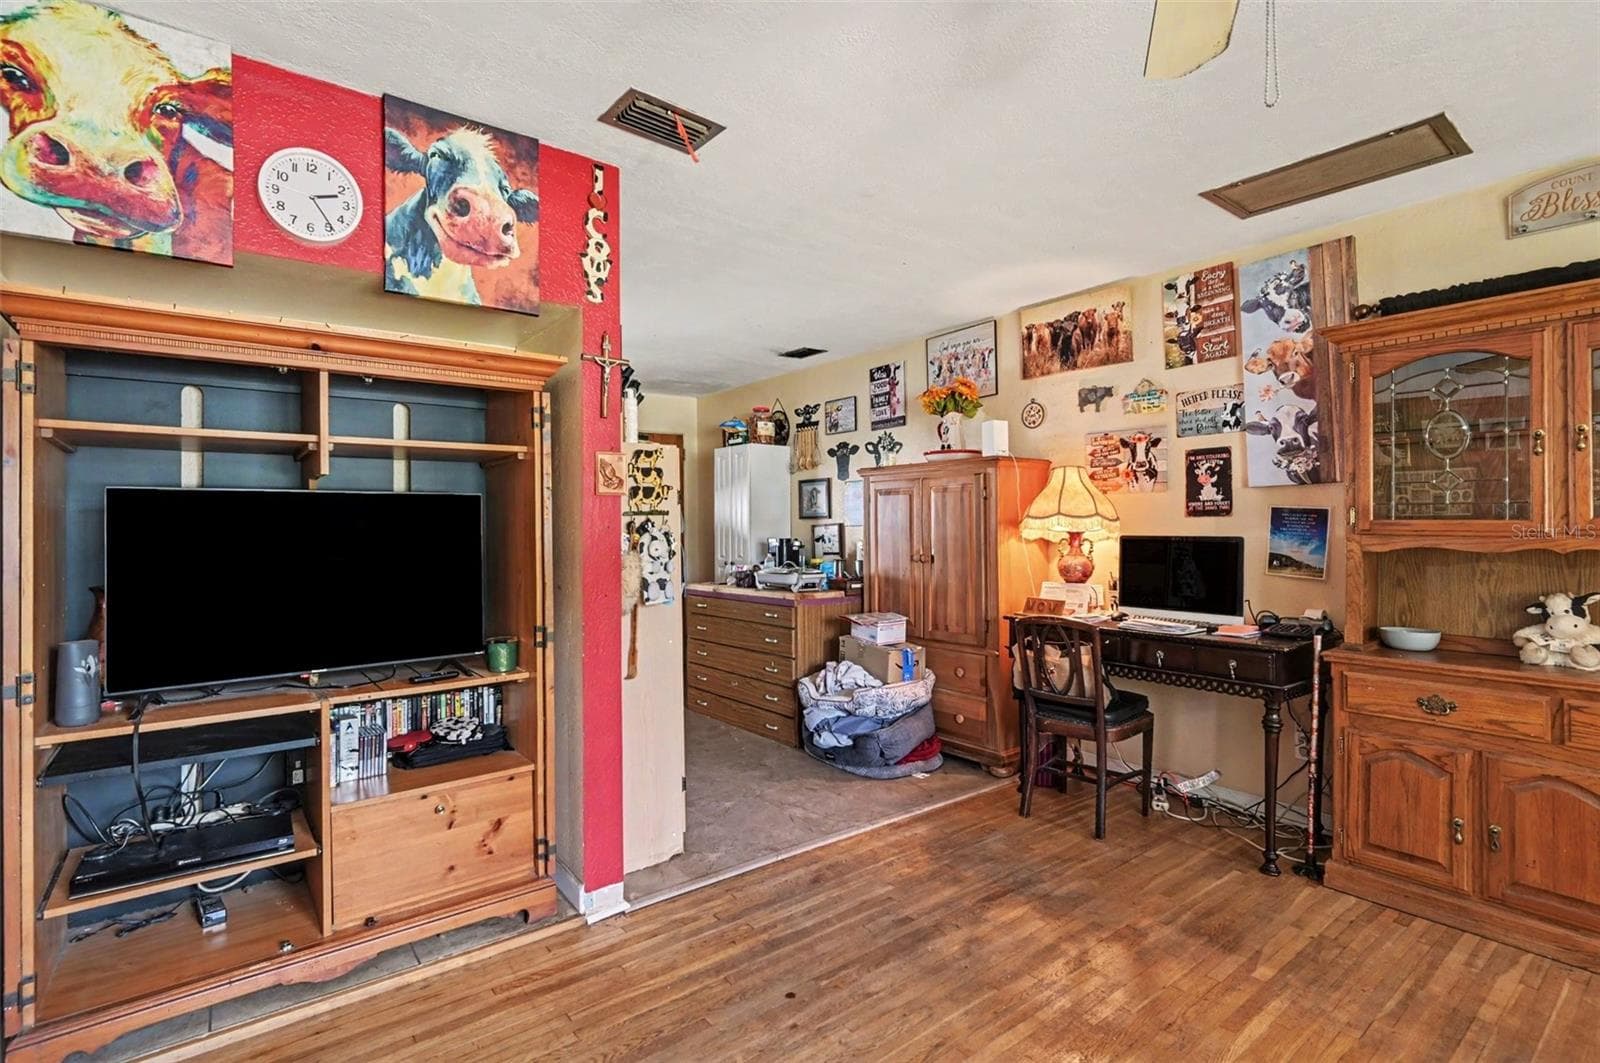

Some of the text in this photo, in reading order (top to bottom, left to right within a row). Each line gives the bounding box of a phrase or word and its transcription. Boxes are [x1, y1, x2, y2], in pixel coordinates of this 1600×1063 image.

[306, 162, 318, 174] 12
[276, 170, 289, 182] 10
[327, 171, 332, 181] 1
[1551, 172, 1593, 190] COUNT
[271, 183, 280, 194] 9
[337, 184, 346, 195] 2
[276, 200, 286, 211] 8
[342, 201, 350, 211] 3
[290, 214, 298, 224] 7
[337, 215, 345, 224] 4
[306, 222, 315, 233] 6
[1201, 340, 1229, 354] Start
